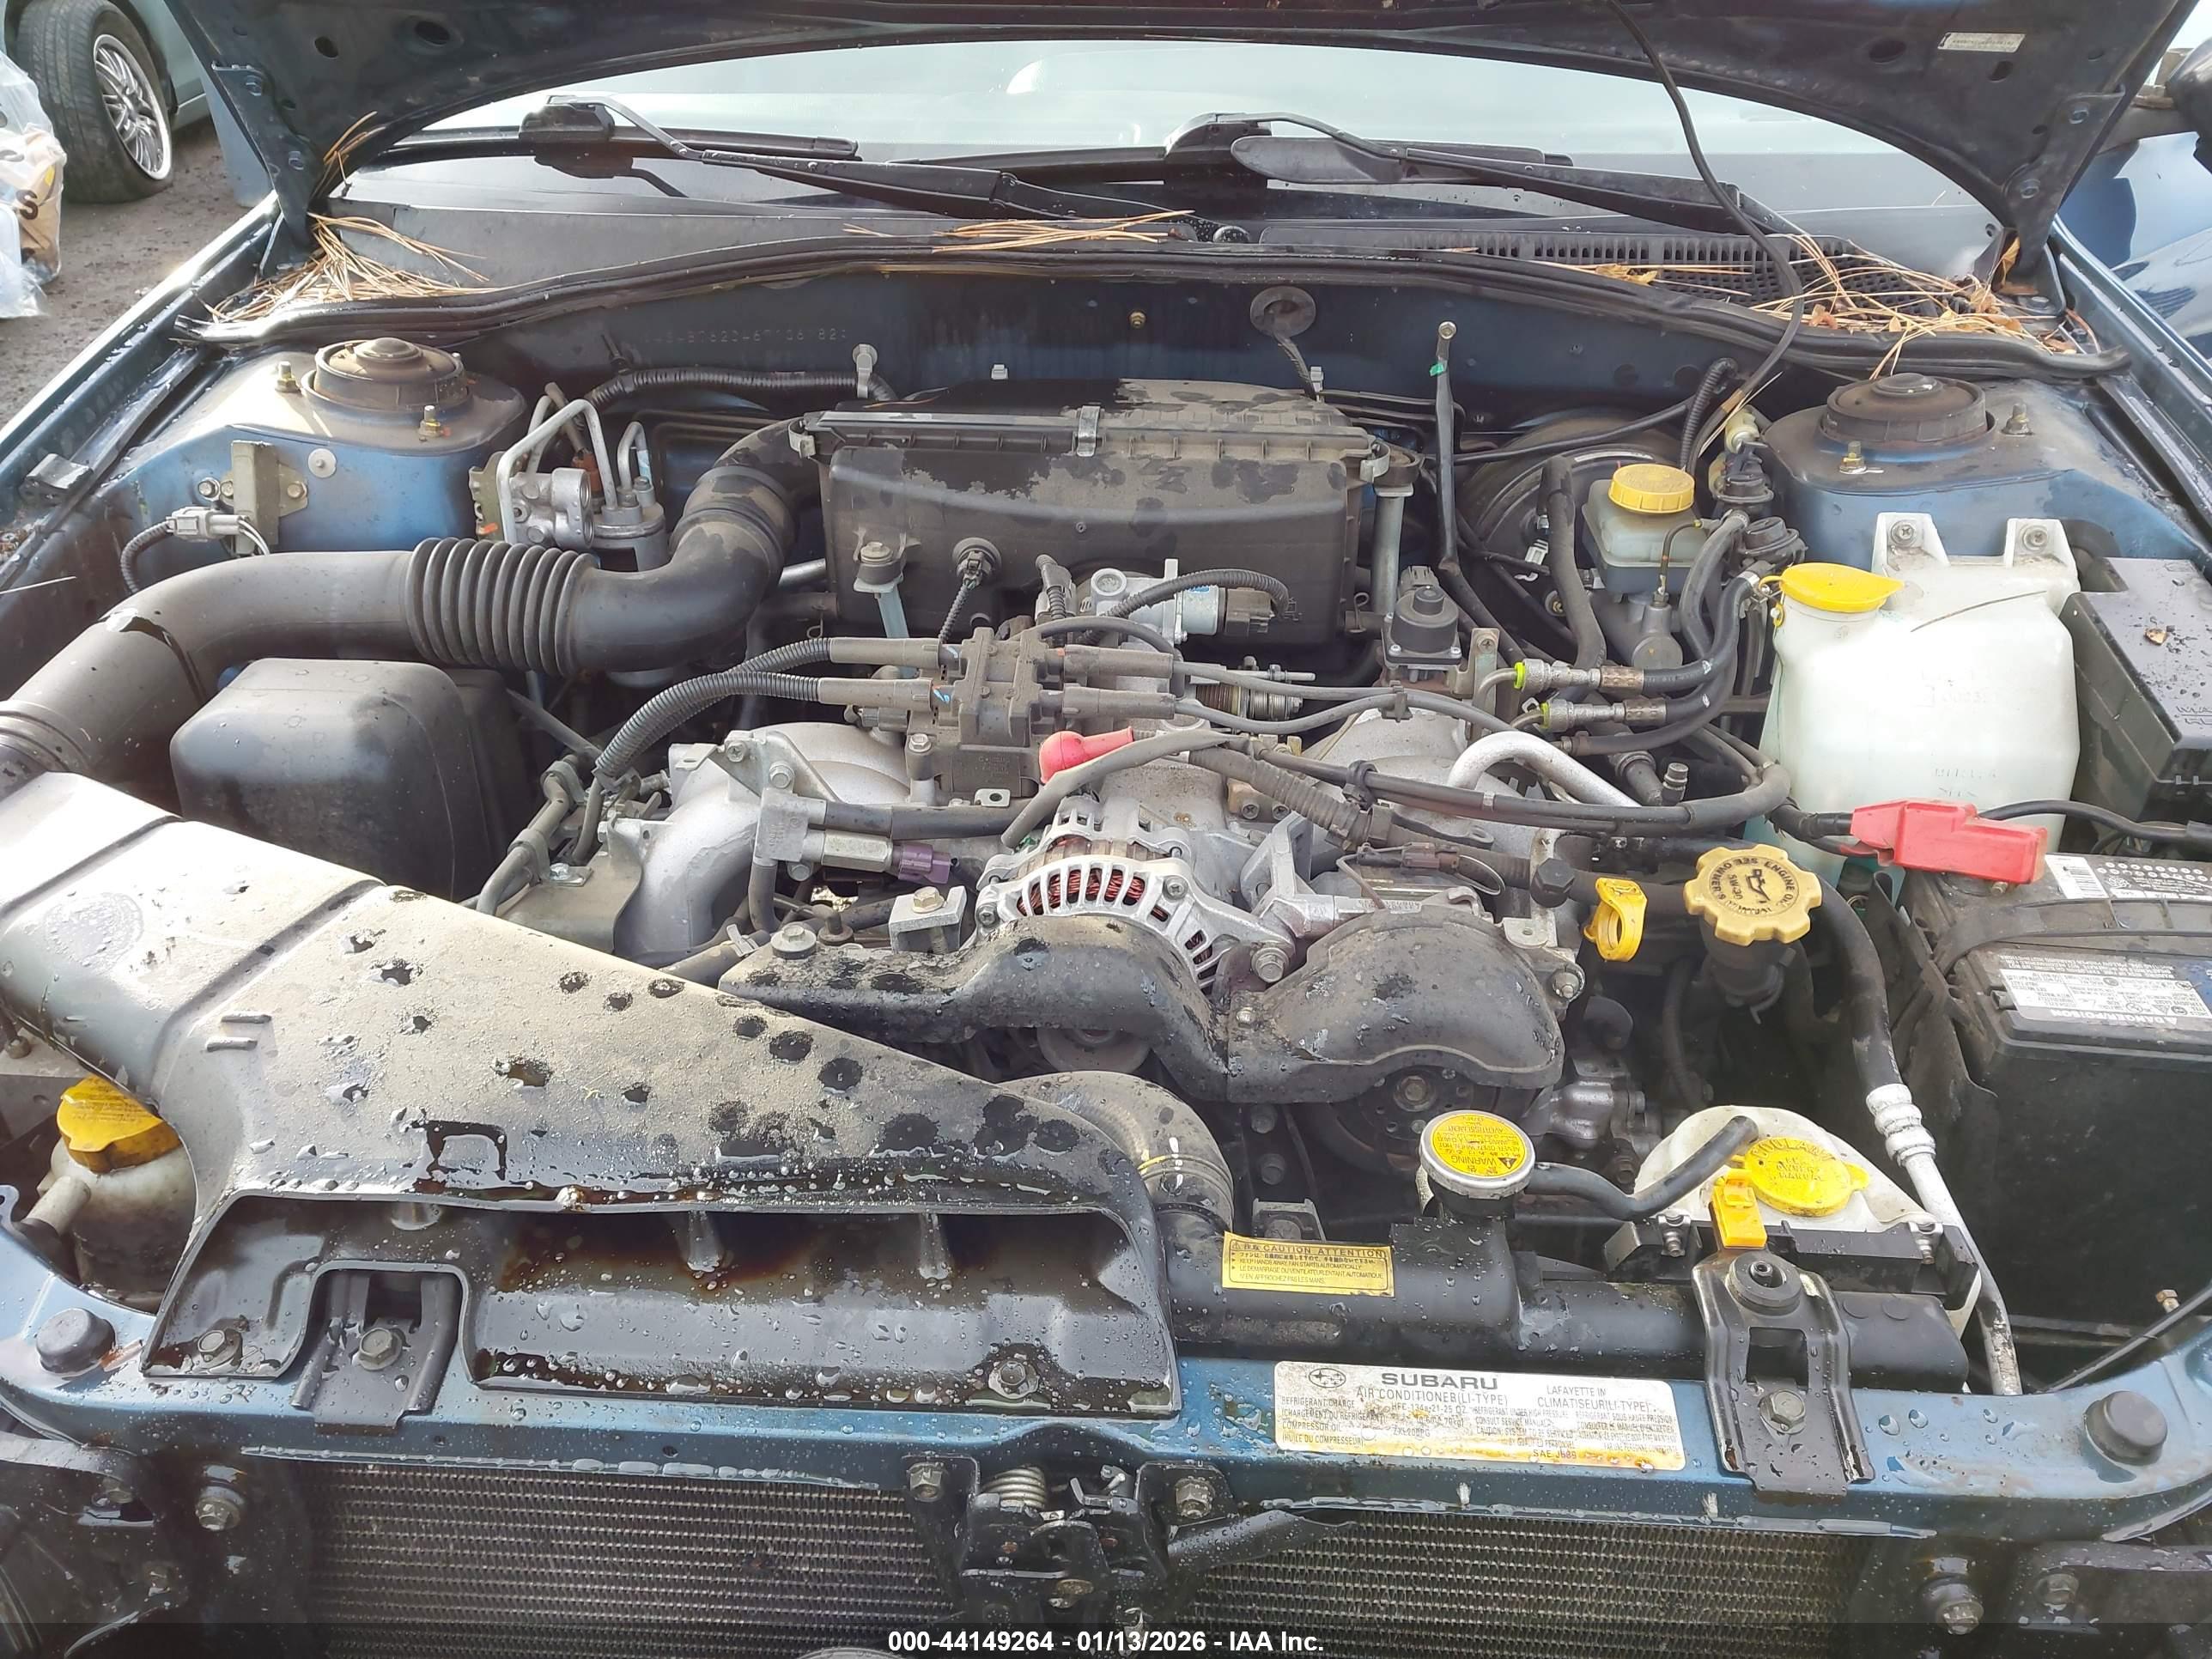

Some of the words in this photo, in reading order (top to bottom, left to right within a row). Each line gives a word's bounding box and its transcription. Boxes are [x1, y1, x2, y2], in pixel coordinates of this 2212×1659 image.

[1764, 860, 1796, 891] ENGINE
[1449, 1155, 1498, 1166] WARNING
[1263, 1244, 1311, 1254] CAUTION
[1318, 1248, 1382, 1258] ATTENTION
[1381, 1372, 1498, 1390] SUBARU
[1356, 1387, 1375, 1400] AIR
[1378, 1388, 1509, 1406] CONDITIONER(LI-TYPE)
[1547, 1385, 1595, 1397] LAFAYETTE
[1281, 1395, 1327, 1407] REFRIGERANT
[1328, 1398, 1355, 1409] CHARGE
[1328, 1409, 1339, 1420] DU
[1282, 1421, 1329, 1431] COMPRESSOR
[1331, 1423, 1342, 1432] OIL
[1475, 1416, 1500, 1425] CONSULT
[1501, 1417, 1524, 1427] SERVICE
[1304, 1434, 1314, 1443] DU
[1533, 1449, 1553, 1458] SAE
